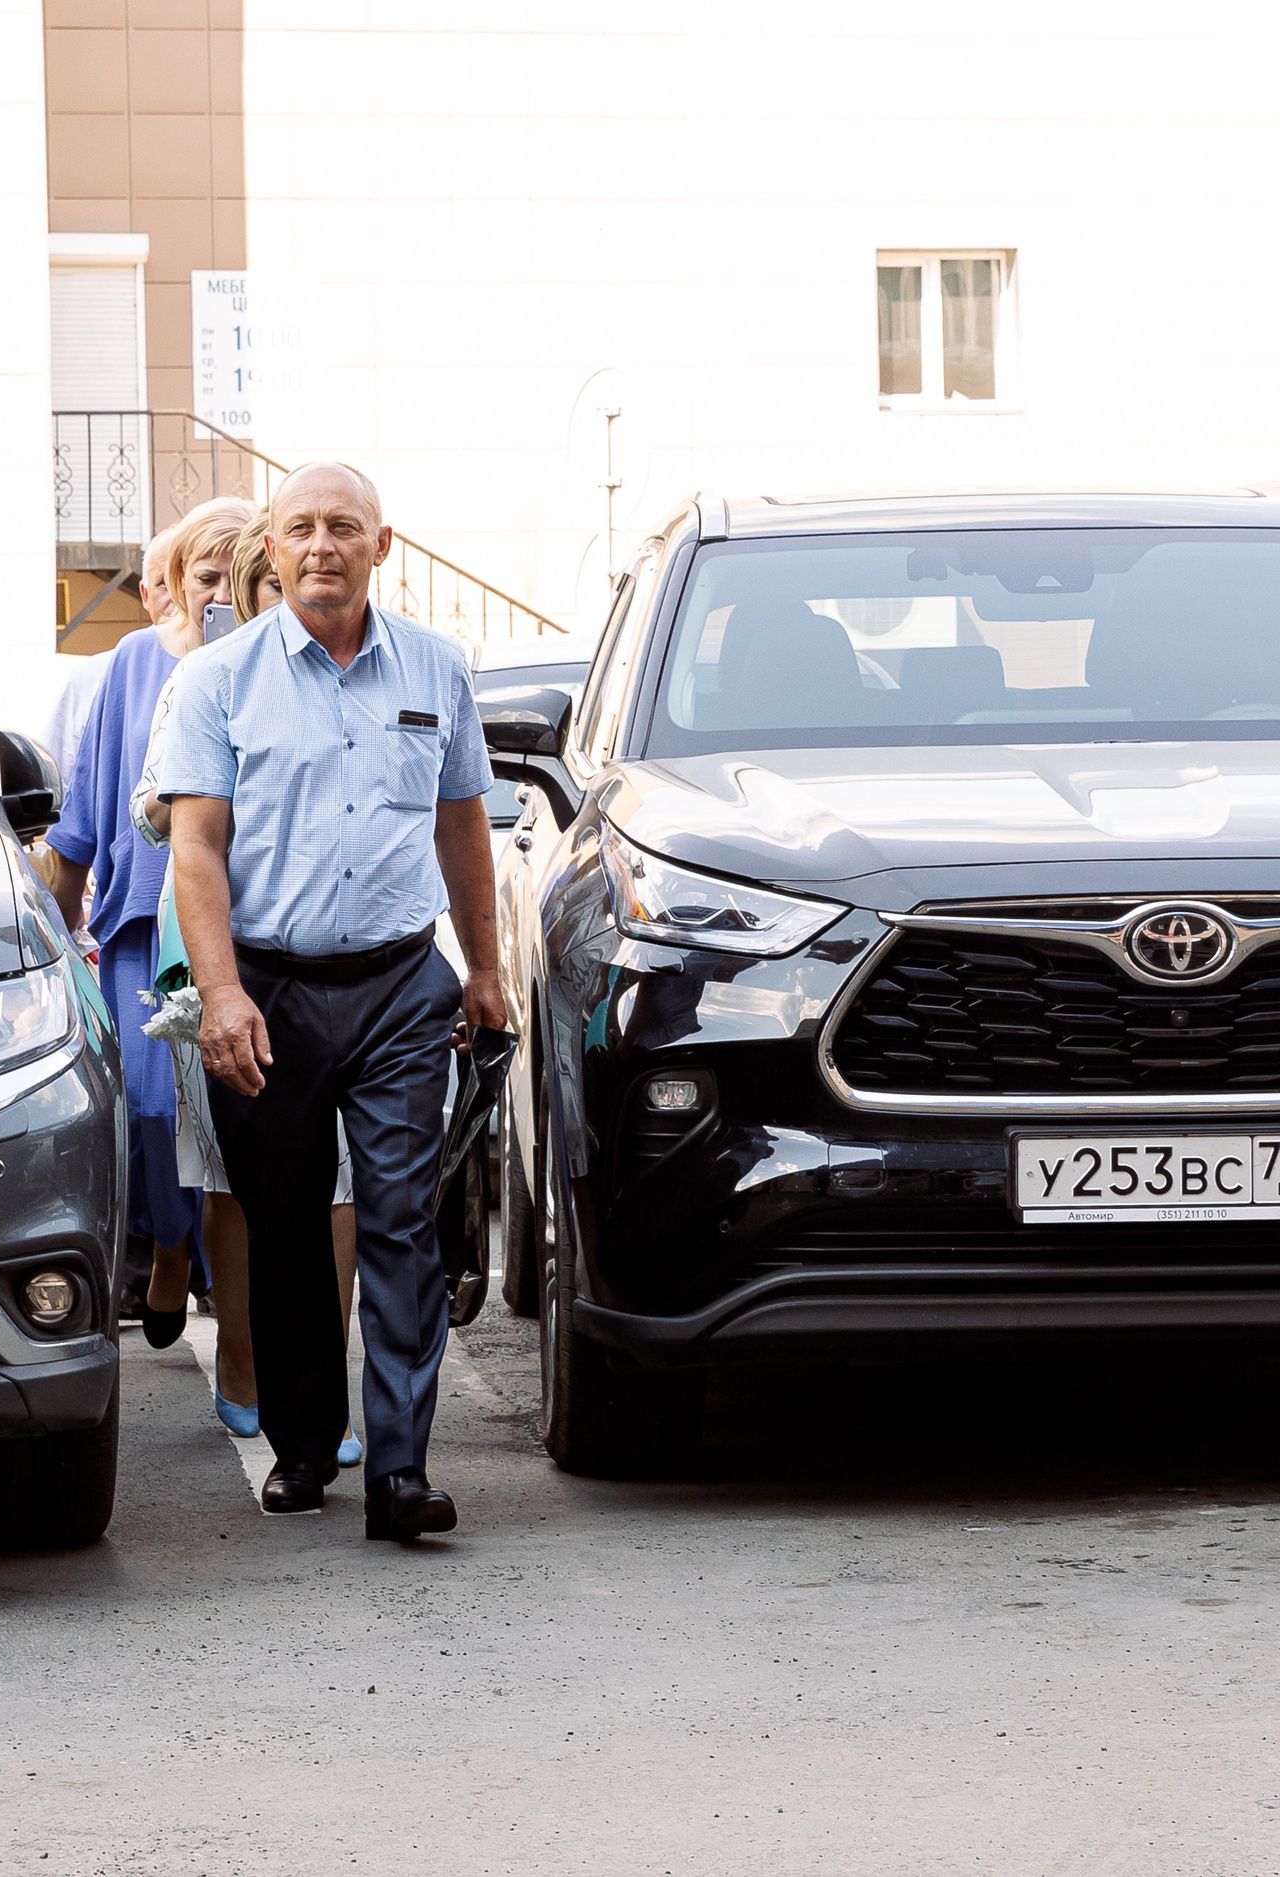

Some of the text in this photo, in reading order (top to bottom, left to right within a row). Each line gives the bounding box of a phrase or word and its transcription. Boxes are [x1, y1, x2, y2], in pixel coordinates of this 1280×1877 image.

[1037, 1146, 1244, 1198] У253ВС
[1068, 1209, 1227, 1221] Автомир (351) 211 10 10
